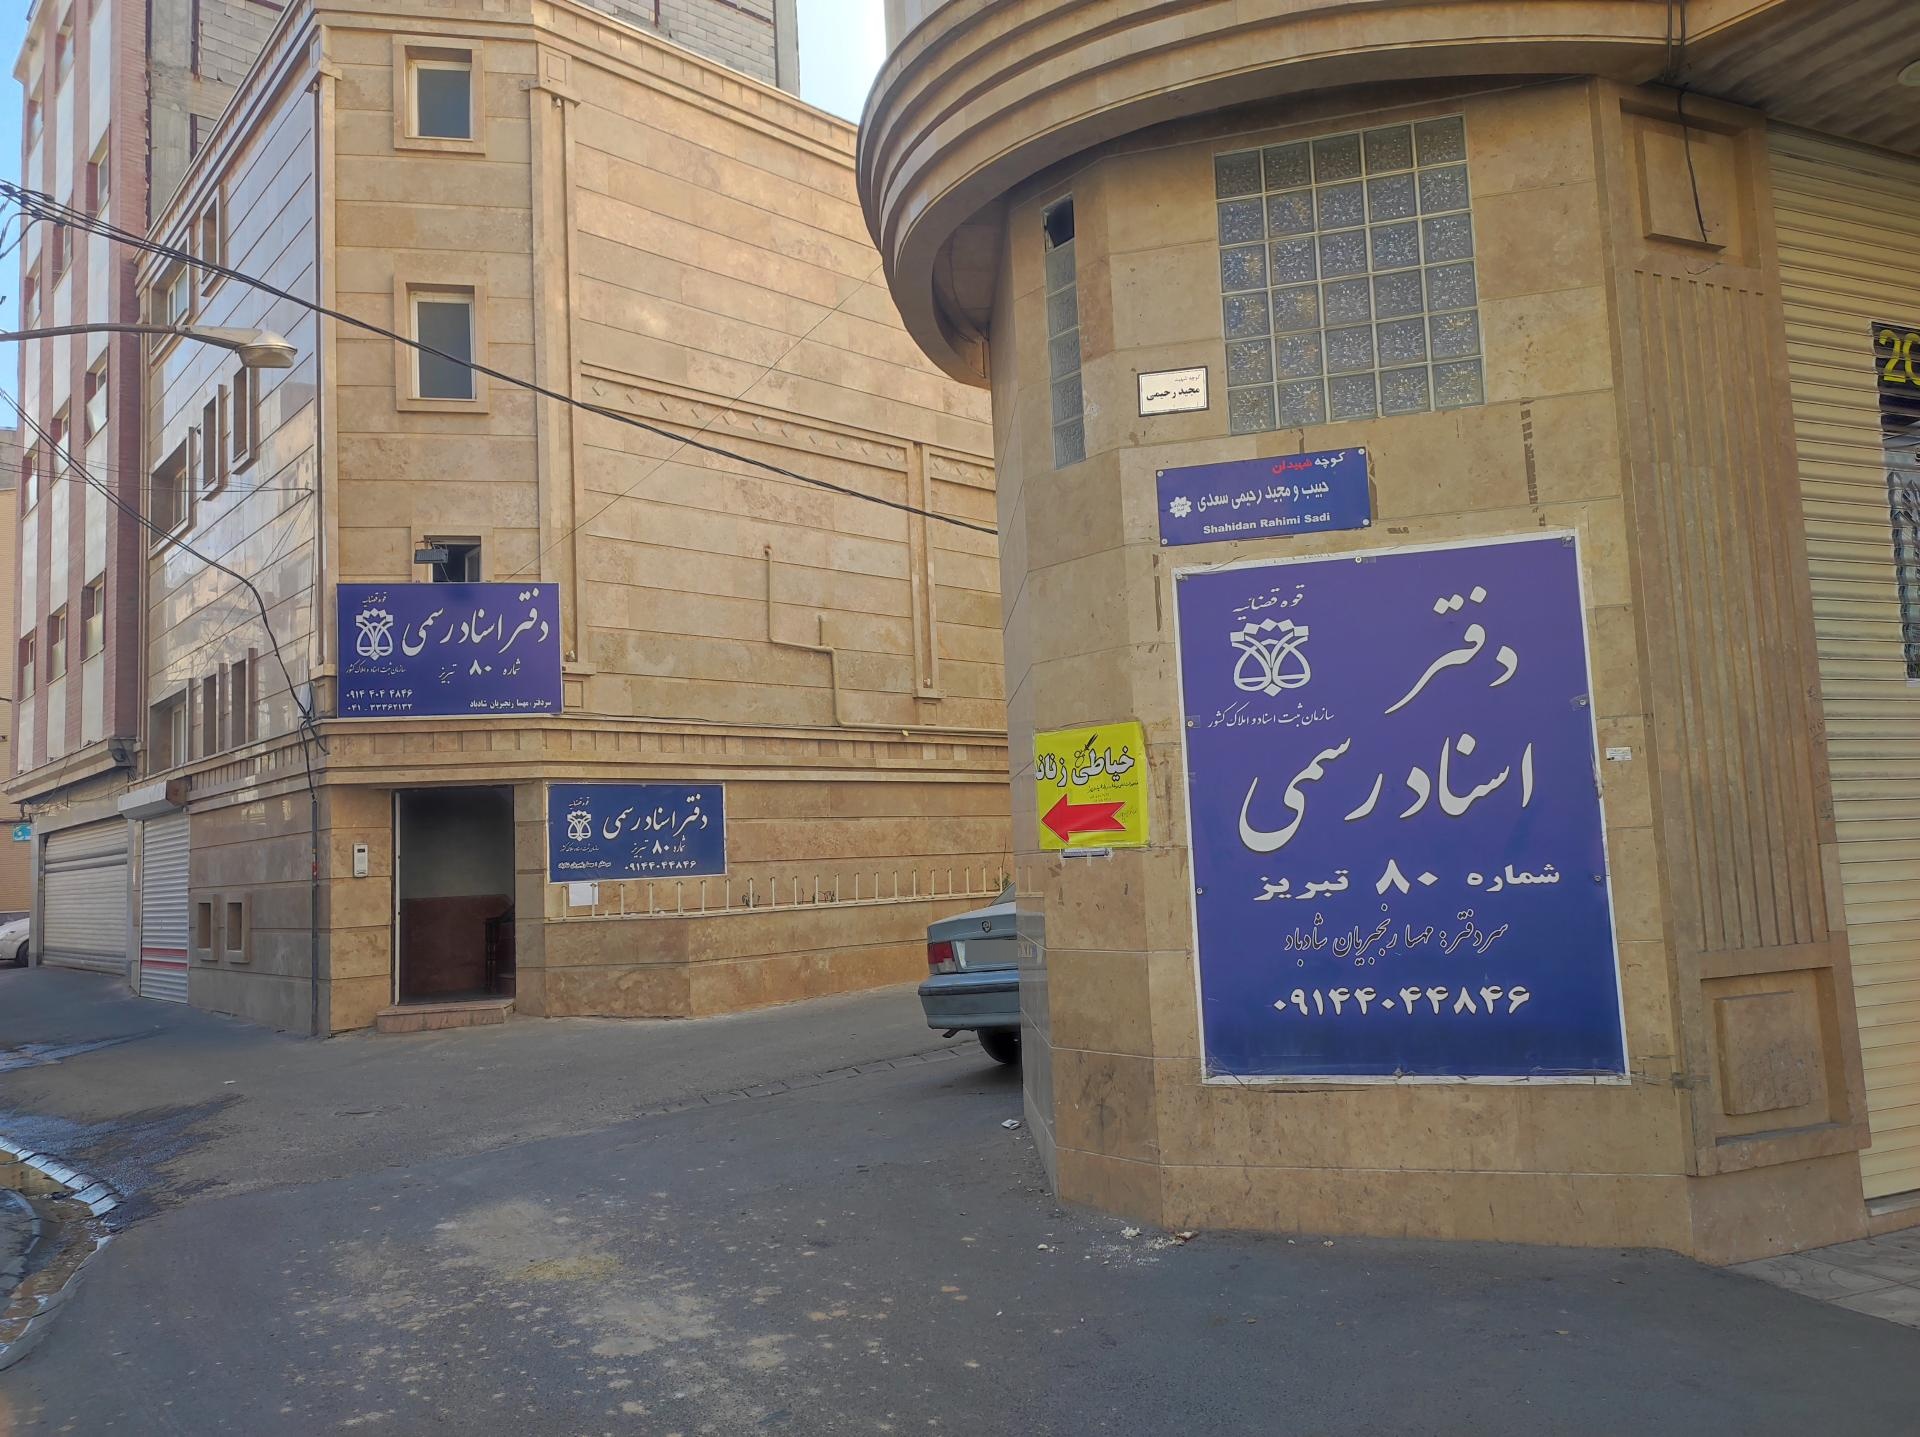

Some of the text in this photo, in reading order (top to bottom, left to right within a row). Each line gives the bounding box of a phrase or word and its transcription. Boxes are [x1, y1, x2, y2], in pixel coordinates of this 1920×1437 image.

[1147, 387, 1200, 401] مجید رحیمی
[1271, 452, 1346, 475] کوچه شهیدان
[1231, 491, 1262, 510] رحیمی
[1265, 485, 1291, 503] مجید
[1293, 488, 1299, 502] و
[1301, 480, 1329, 498] حبیب
[1197, 494, 1229, 512] سعدی
[1203, 513, 1331, 534] Shahidan Rahimi Sadi
[1280, 584, 1305, 608] قوه
[401, 587, 549, 657] دفتر اسناد رسمی
[1385, 585, 1519, 714] دفتر
[439, 658, 521, 684] شماره ۸۰ تبریز
[346, 689, 413, 699] ۰۹۱۴ ۴۰۴ ۴۸۴۶
[1208, 701, 1237, 728] کشور
[1226, 701, 1250, 727] املاک
[1257, 713, 1276, 724] اسناد
[1278, 702, 1303, 727] ثبت
[1302, 707, 1335, 726] سازمان
[1071, 746, 1135, 786] خیاطی
[1238, 733, 1534, 852] اسناد رسمی
[602, 793, 708, 840] دفتر اسناد رسمی
[631, 839, 649, 858] تبریز
[652, 840, 670, 854] ۸۰
[624, 860, 697, 871] ۰۹۱۴۴۰۴۴۸۴۶
[1252, 859, 1560, 901] شماره ۸۰ تبریز
[1284, 912, 1328, 968] شادباد
[1332, 903, 1398, 967] رنجبریان
[1404, 923, 1434, 949] مهسا
[1272, 984, 1531, 1017] ۰۹۱۴۴۰۴۴۸۴۶
